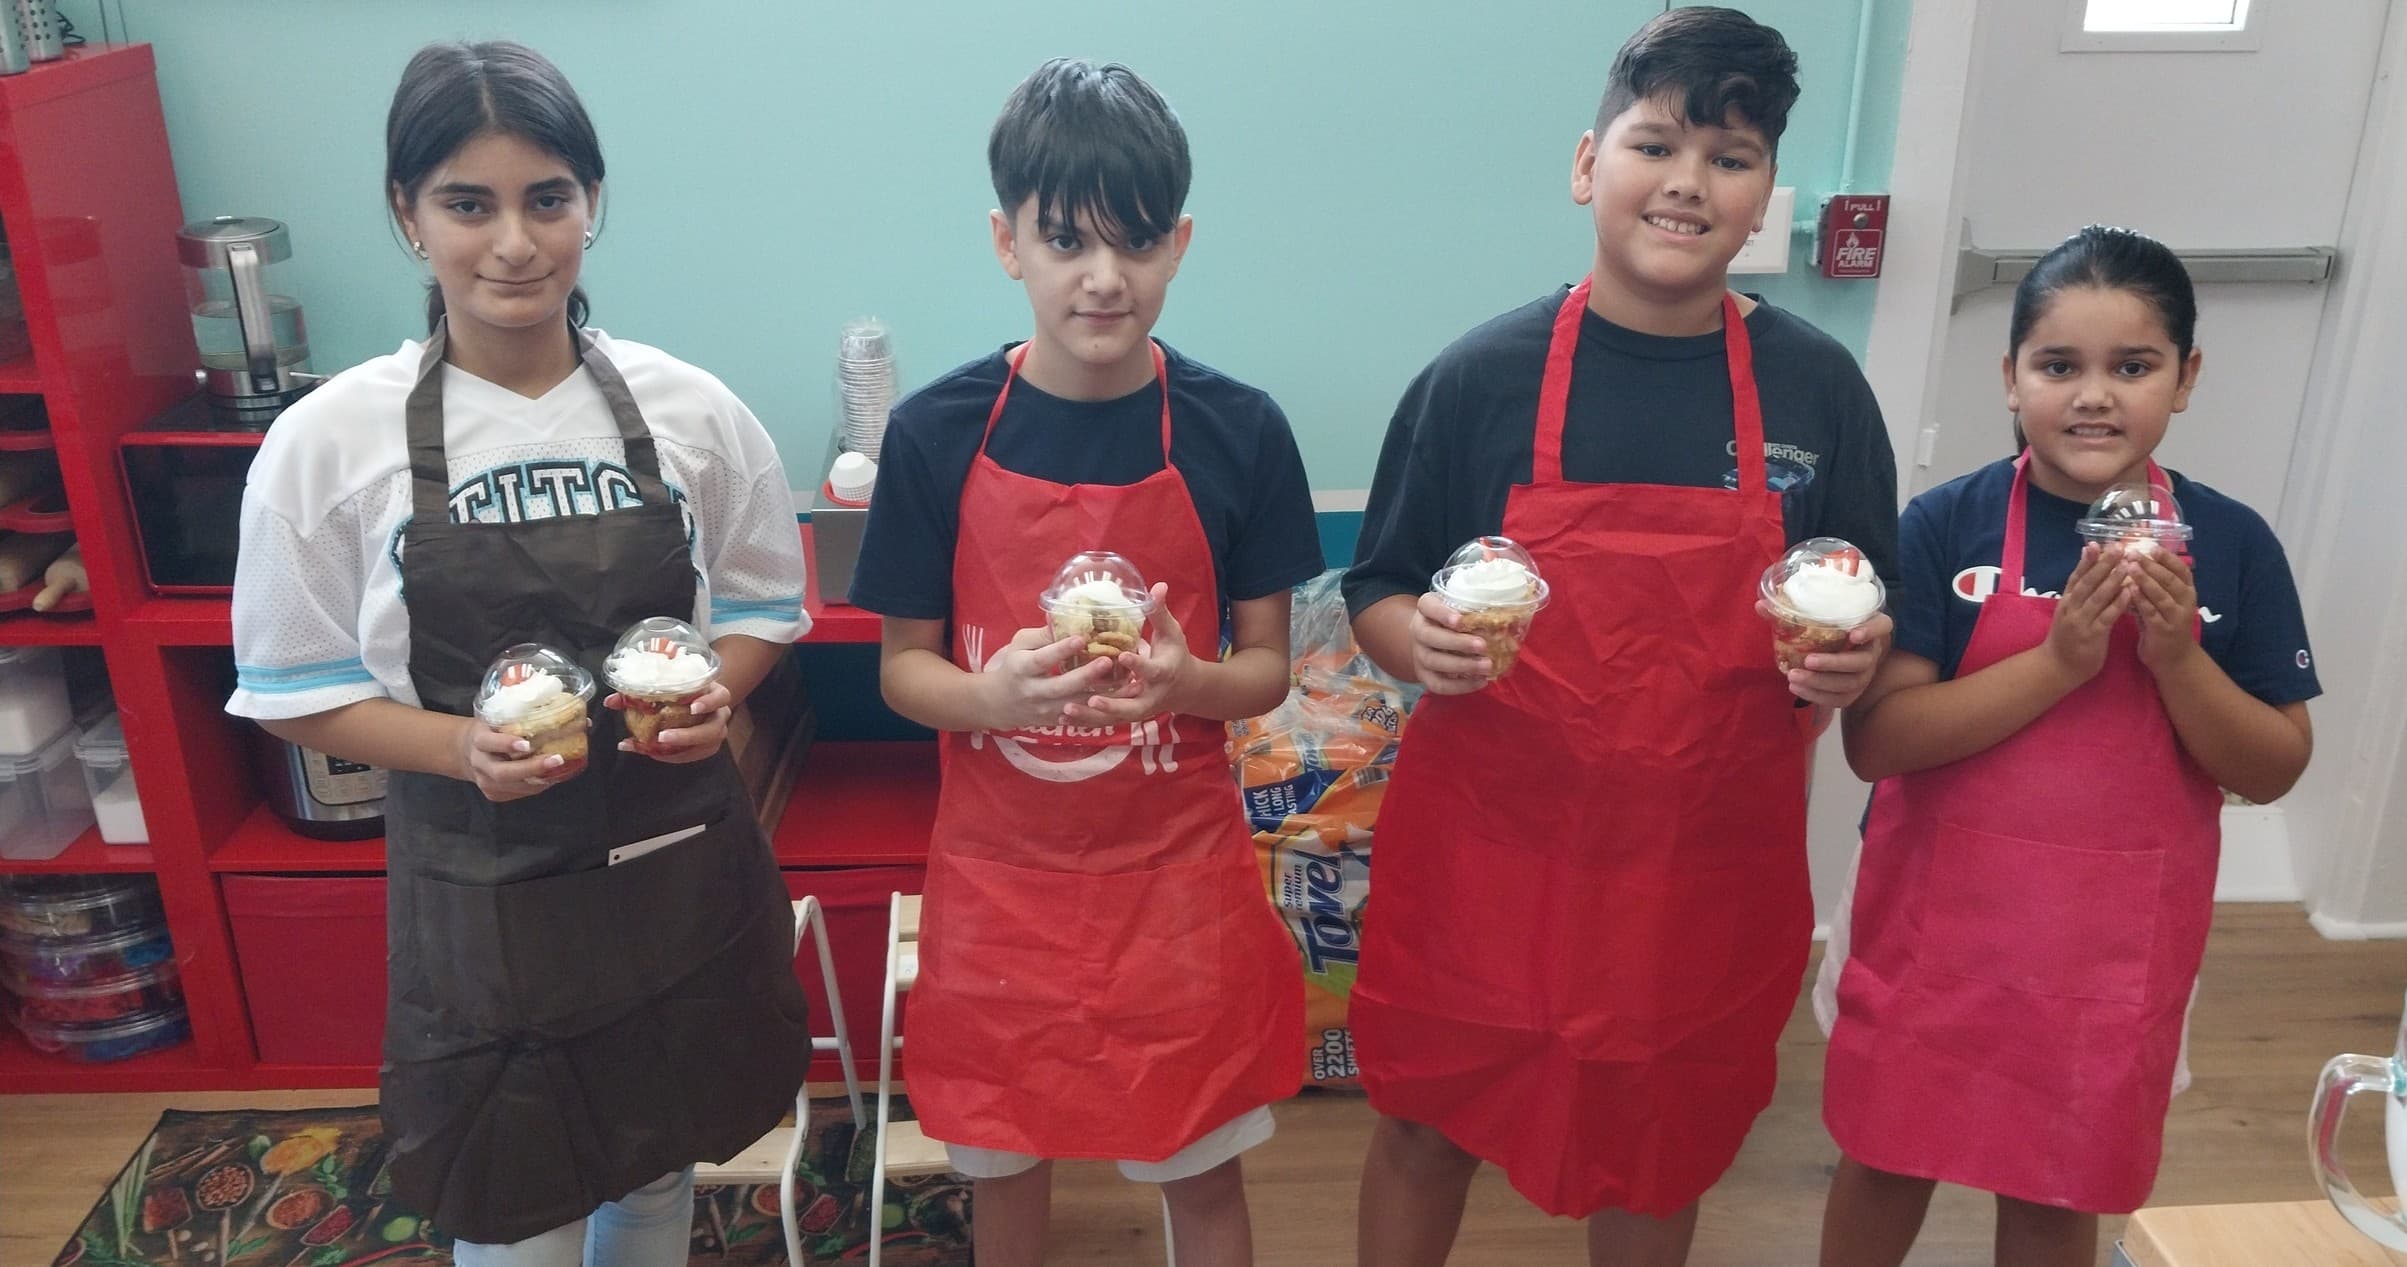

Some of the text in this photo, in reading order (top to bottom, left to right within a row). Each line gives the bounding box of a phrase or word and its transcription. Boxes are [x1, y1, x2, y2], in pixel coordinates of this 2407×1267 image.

[1836, 247, 1877, 261] FIRE
[1837, 260, 1874, 268] ALARM
[1271, 787, 1285, 812] LONG
[1292, 848, 1360, 975] Towel
[1312, 1048, 1326, 1080] OVER
[1324, 1028, 1346, 1078] 2200
